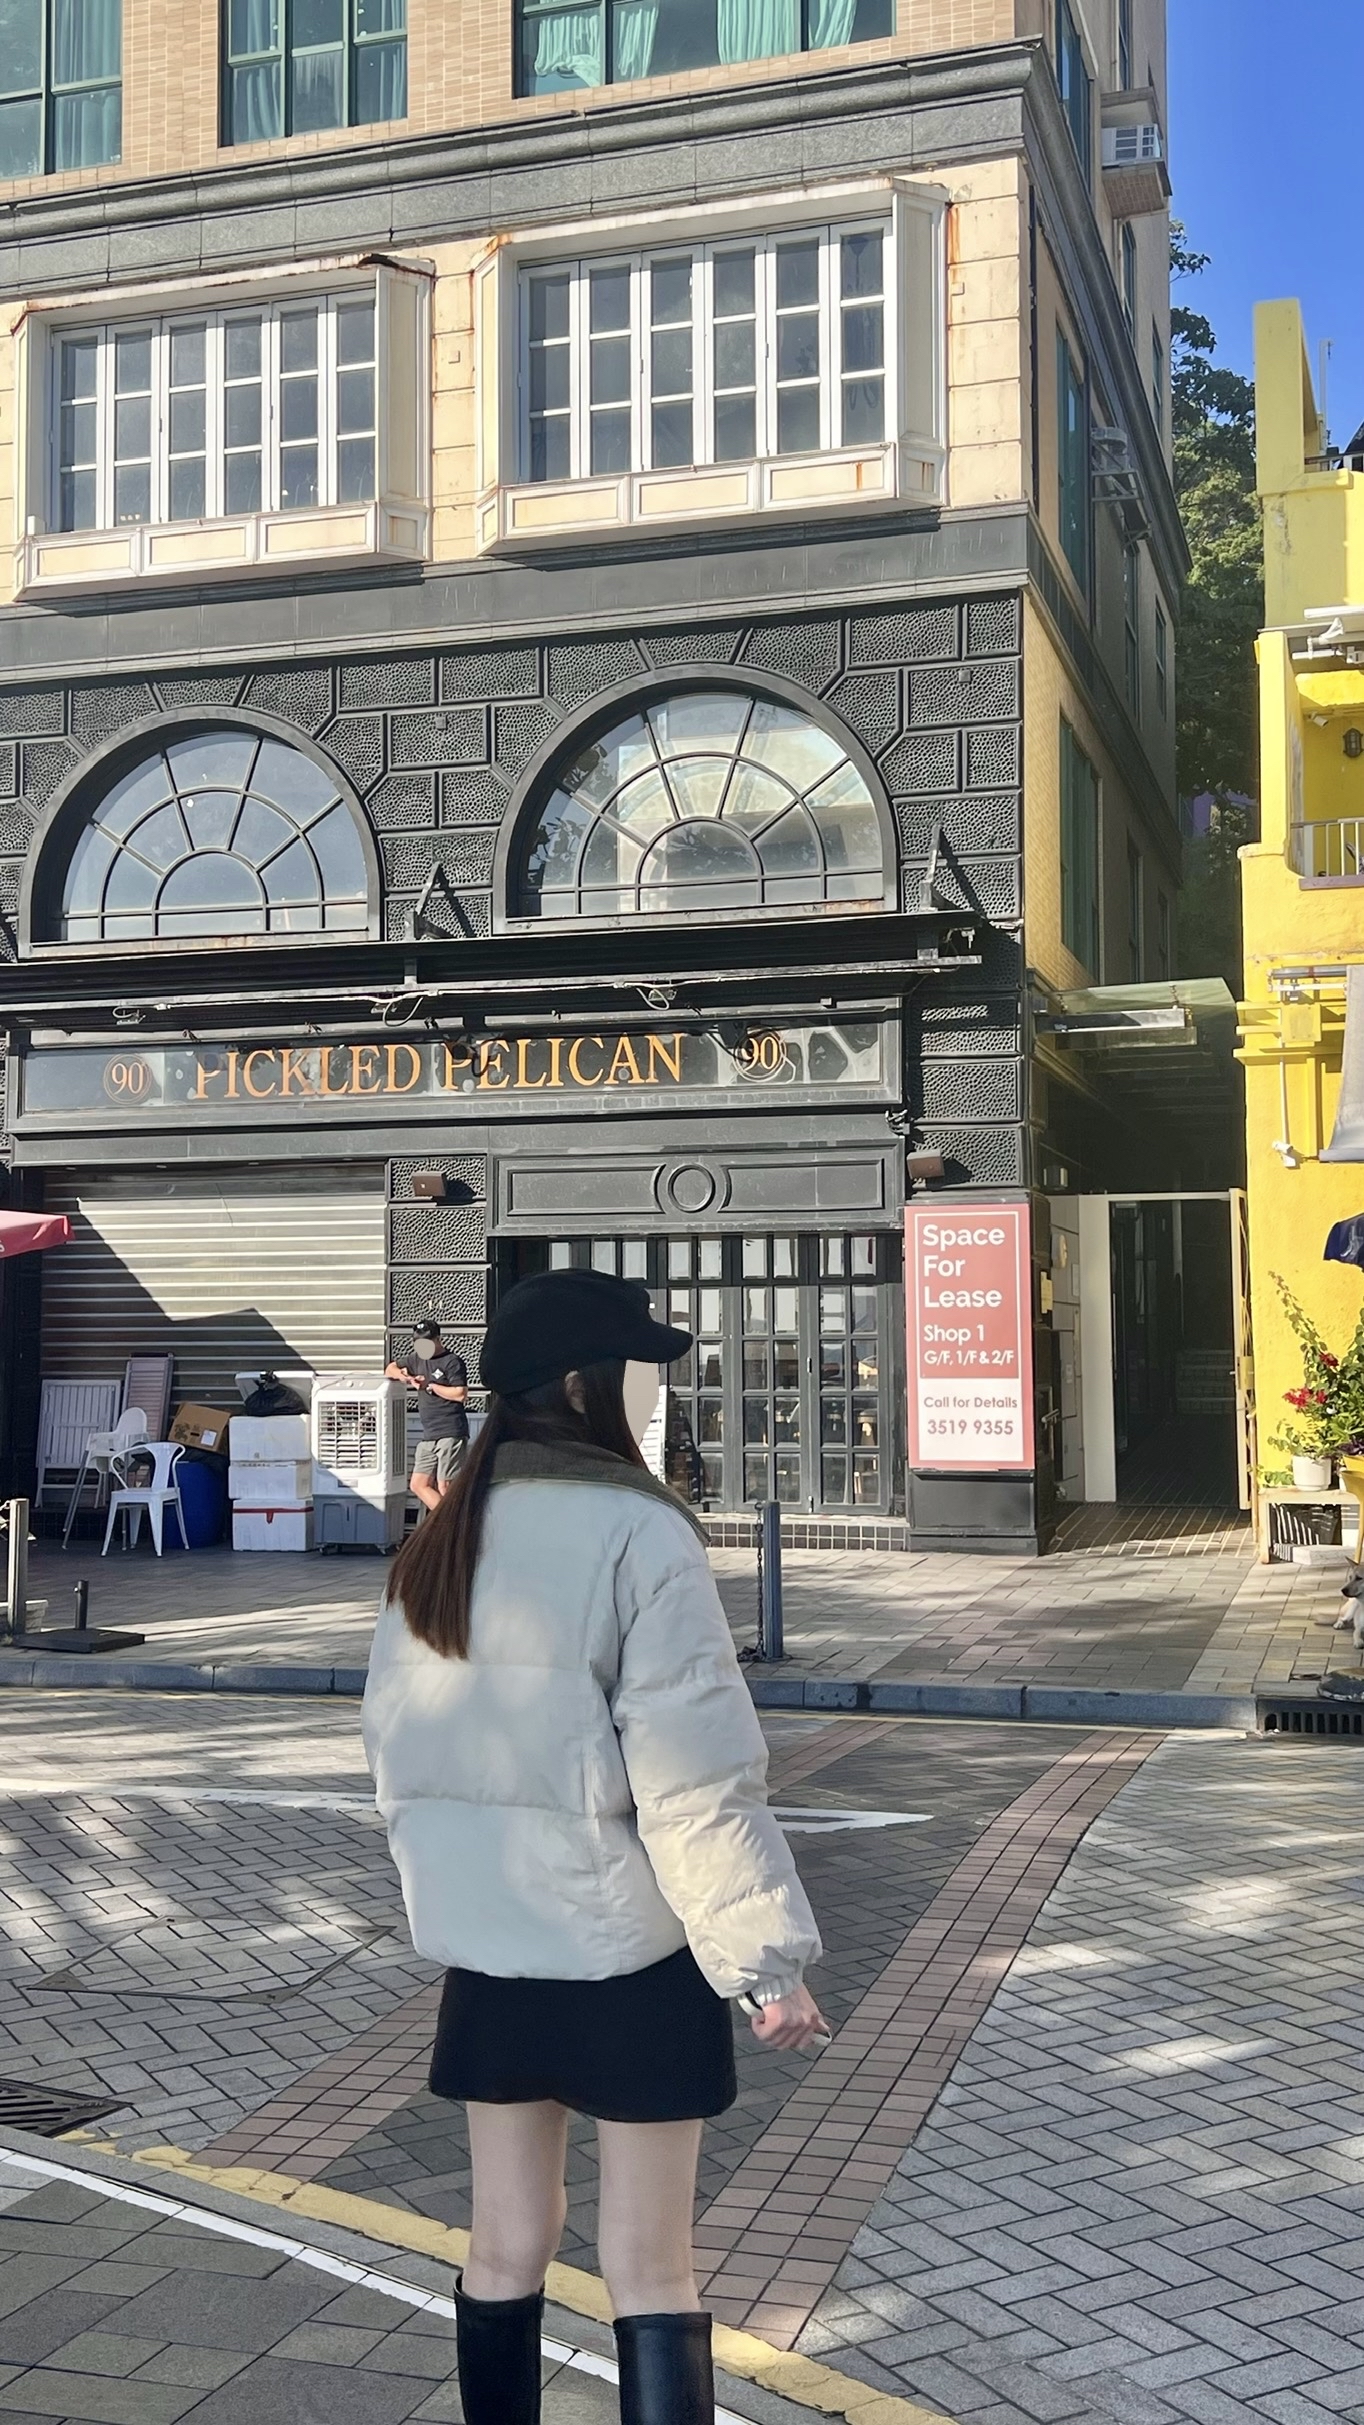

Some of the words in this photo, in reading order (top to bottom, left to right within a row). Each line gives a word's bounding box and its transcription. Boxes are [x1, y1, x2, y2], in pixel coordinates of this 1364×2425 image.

[111, 1061, 145, 1094] 90
[193, 1043, 422, 1099] PICKLED
[441, 1032, 684, 1090] PELICAN
[741, 1035, 779, 1071] 90
[922, 1224, 1006, 1252] Space
[923, 1255, 966, 1277] For
[924, 1286, 1003, 1308] Lease
[923, 1324, 972, 1346] Shop
[976, 1324, 985, 1342] 1
[923, 1349, 954, 1366] G/F,
[956, 1349, 978, 1366] 1/F
[979, 1350, 990, 1365] &
[991, 1349, 1015, 1366] 2/F
[923, 1396, 950, 1408] Call
[953, 1396, 970, 1408] for
[974, 1396, 1018, 1409] Details
[927, 1420, 968, 1435] 3519
[973, 1420, 1014, 1435] 9355
